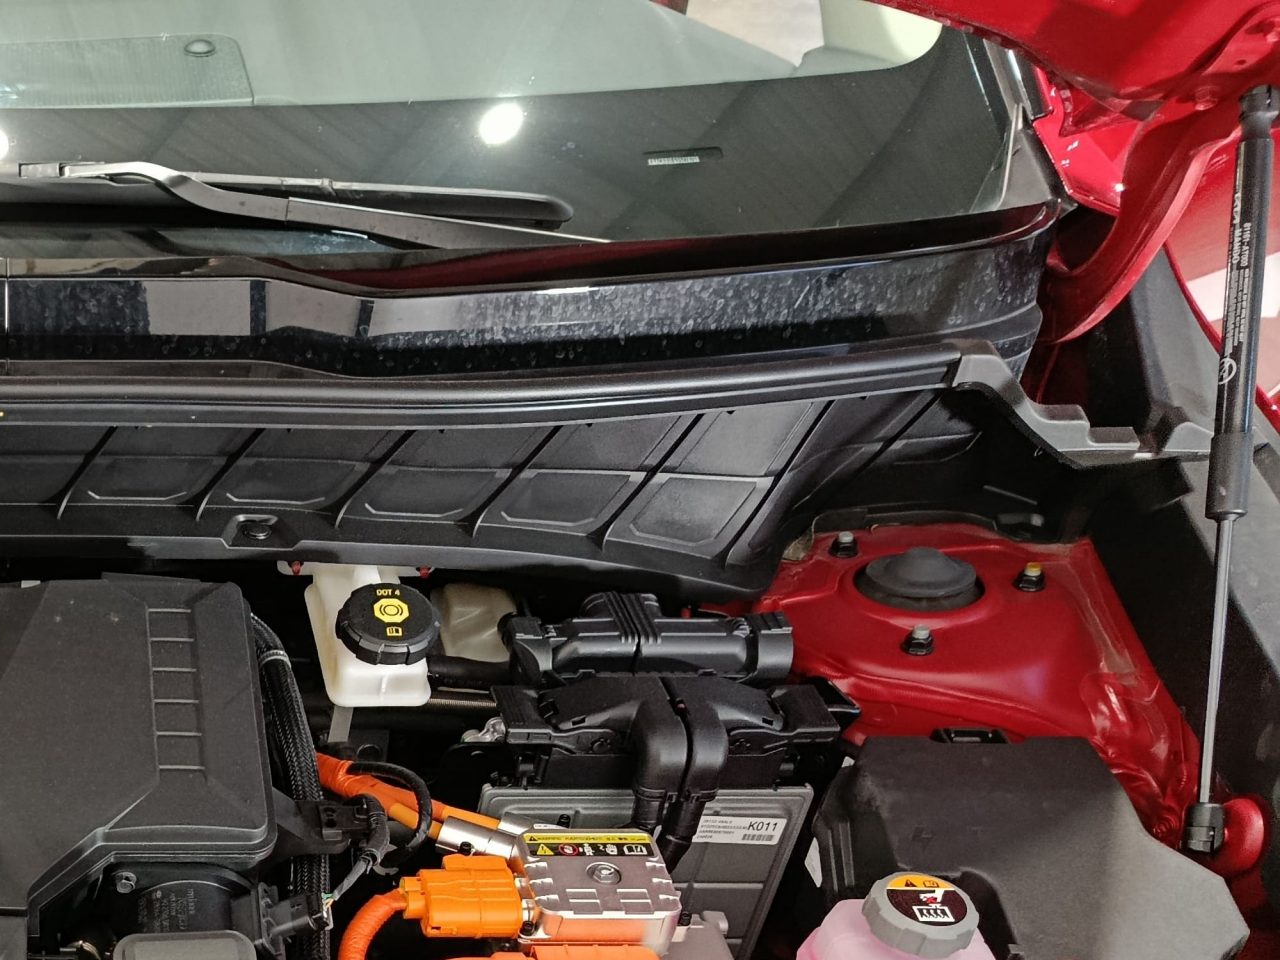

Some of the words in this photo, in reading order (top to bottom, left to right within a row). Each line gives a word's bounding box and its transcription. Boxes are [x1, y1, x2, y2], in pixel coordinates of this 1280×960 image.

[376, 588, 392, 596] DOT
[394, 588, 400, 596] 4
[747, 821, 778, 832] K011
